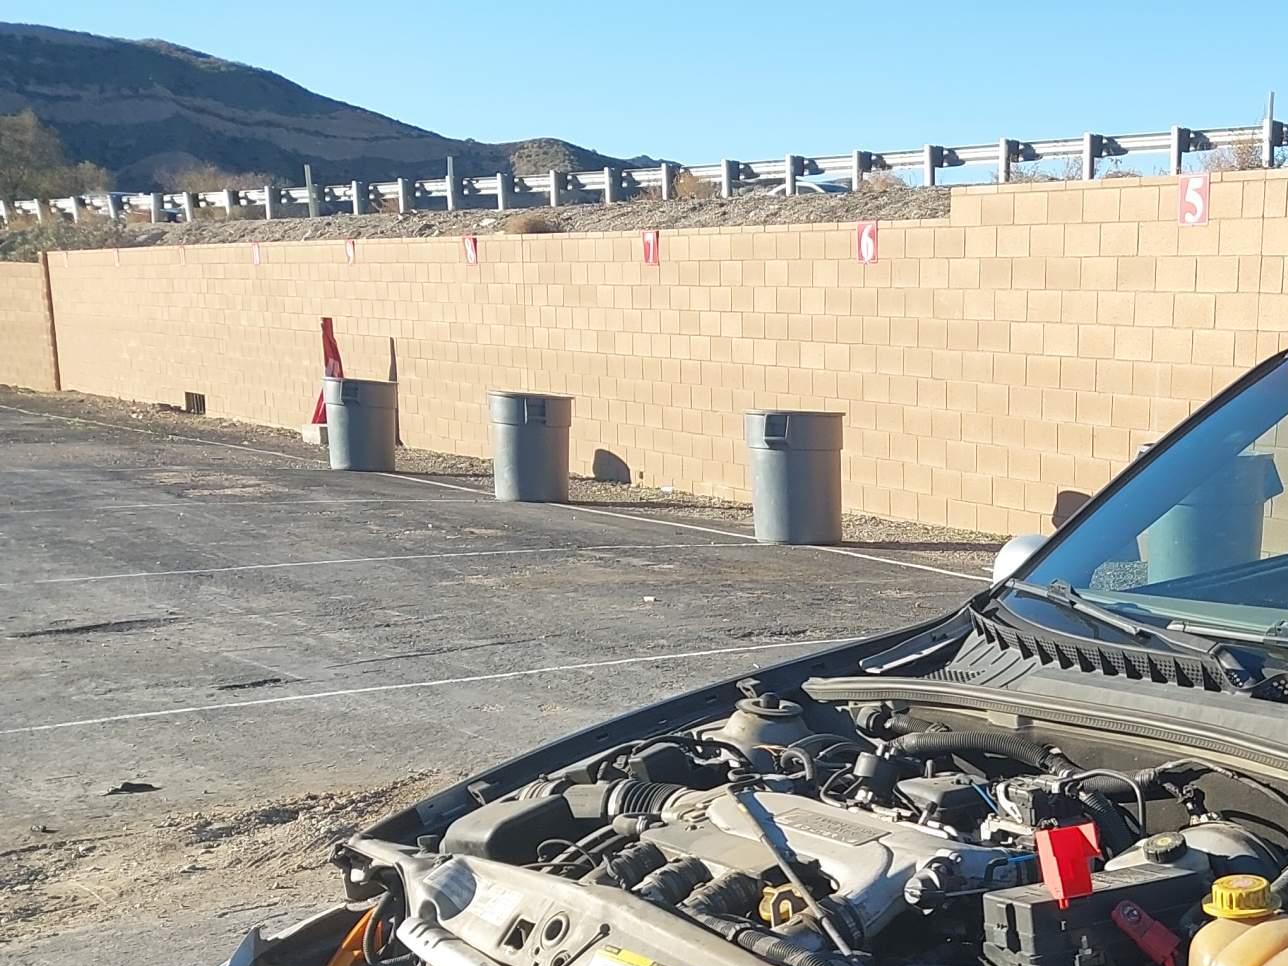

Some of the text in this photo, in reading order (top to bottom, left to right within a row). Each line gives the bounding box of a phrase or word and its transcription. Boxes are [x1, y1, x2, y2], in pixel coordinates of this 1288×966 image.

[1184, 177, 1204, 224] 5
[643, 231, 655, 264] 7
[860, 224, 874, 262] 6
